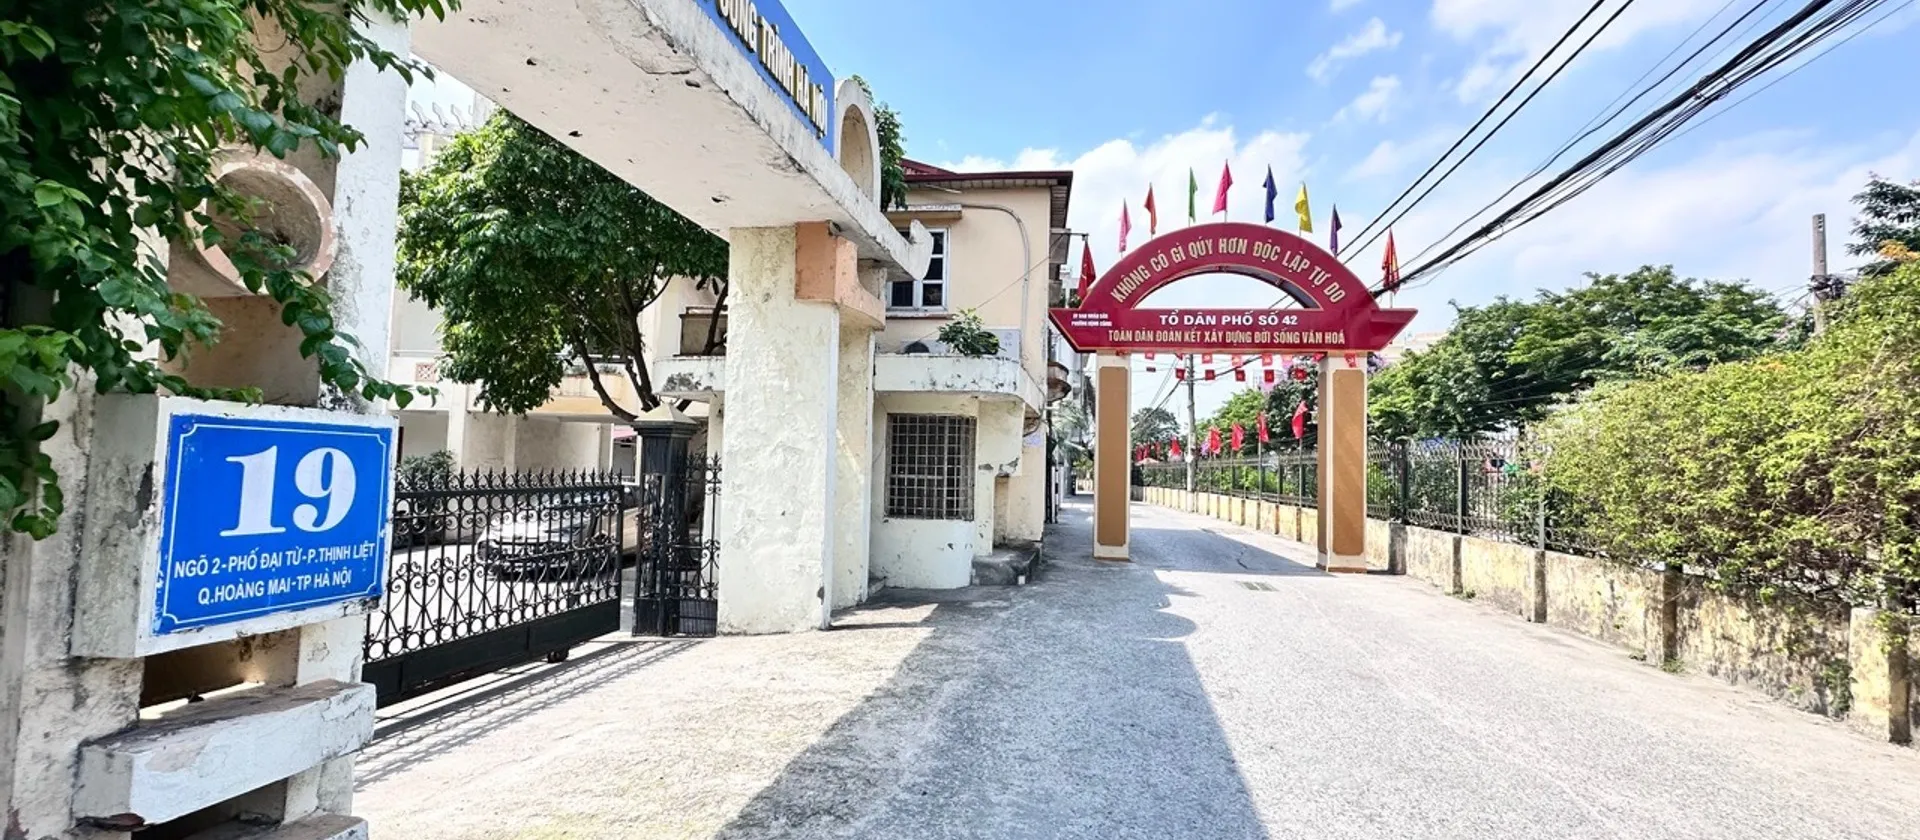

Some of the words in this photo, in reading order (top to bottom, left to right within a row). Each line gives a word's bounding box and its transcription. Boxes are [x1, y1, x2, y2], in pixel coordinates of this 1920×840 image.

[761, 15, 795, 98] TRÌNH
[796, 62, 810, 117] HÀ
[1109, 265, 1151, 303] KHÔNG
[1150, 249, 1169, 272] CÓ
[1170, 242, 1186, 263] GÌ
[1218, 237, 1248, 255] HƠN
[1252, 239, 1280, 262] ĐỘC
[1282, 251, 1310, 272] LẬP
[1308, 266, 1331, 288] TỰ
[1323, 282, 1346, 303] DO
[1108, 328, 1132, 342] TOÀN
[1134, 327, 1154, 342] DÂN
[1156, 328, 1182, 342] ĐOÀN
[1184, 326, 1201, 343] KẾT
[1204, 329, 1224, 343] XÂY
[1225, 330, 1252, 346] DỰNG
[1254, 328, 1271, 343] ĐỜI
[1273, 327, 1300, 344] SỐNG
[1302, 329, 1323, 344] VĂN
[1324, 329, 1345, 344] HOÁ
[1159, 308, 1179, 325] TỔ
[1183, 311, 1216, 325] DÂN
[1221, 310, 1254, 325] PHỐ
[1258, 310, 1280, 325] SỐ
[1281, 315, 1298, 325] 42
[219, 445, 357, 537] 19
[173, 554, 209, 578] NGÕ
[260, 551, 283, 572] ĐẠI
[352, 540, 375, 561] LIỆT
[198, 577, 265, 605] Q.HOÀNG
[267, 575, 312, 595] MAI-TP
[313, 567, 330, 588] HÀ
[331, 566, 353, 588] NỘI
